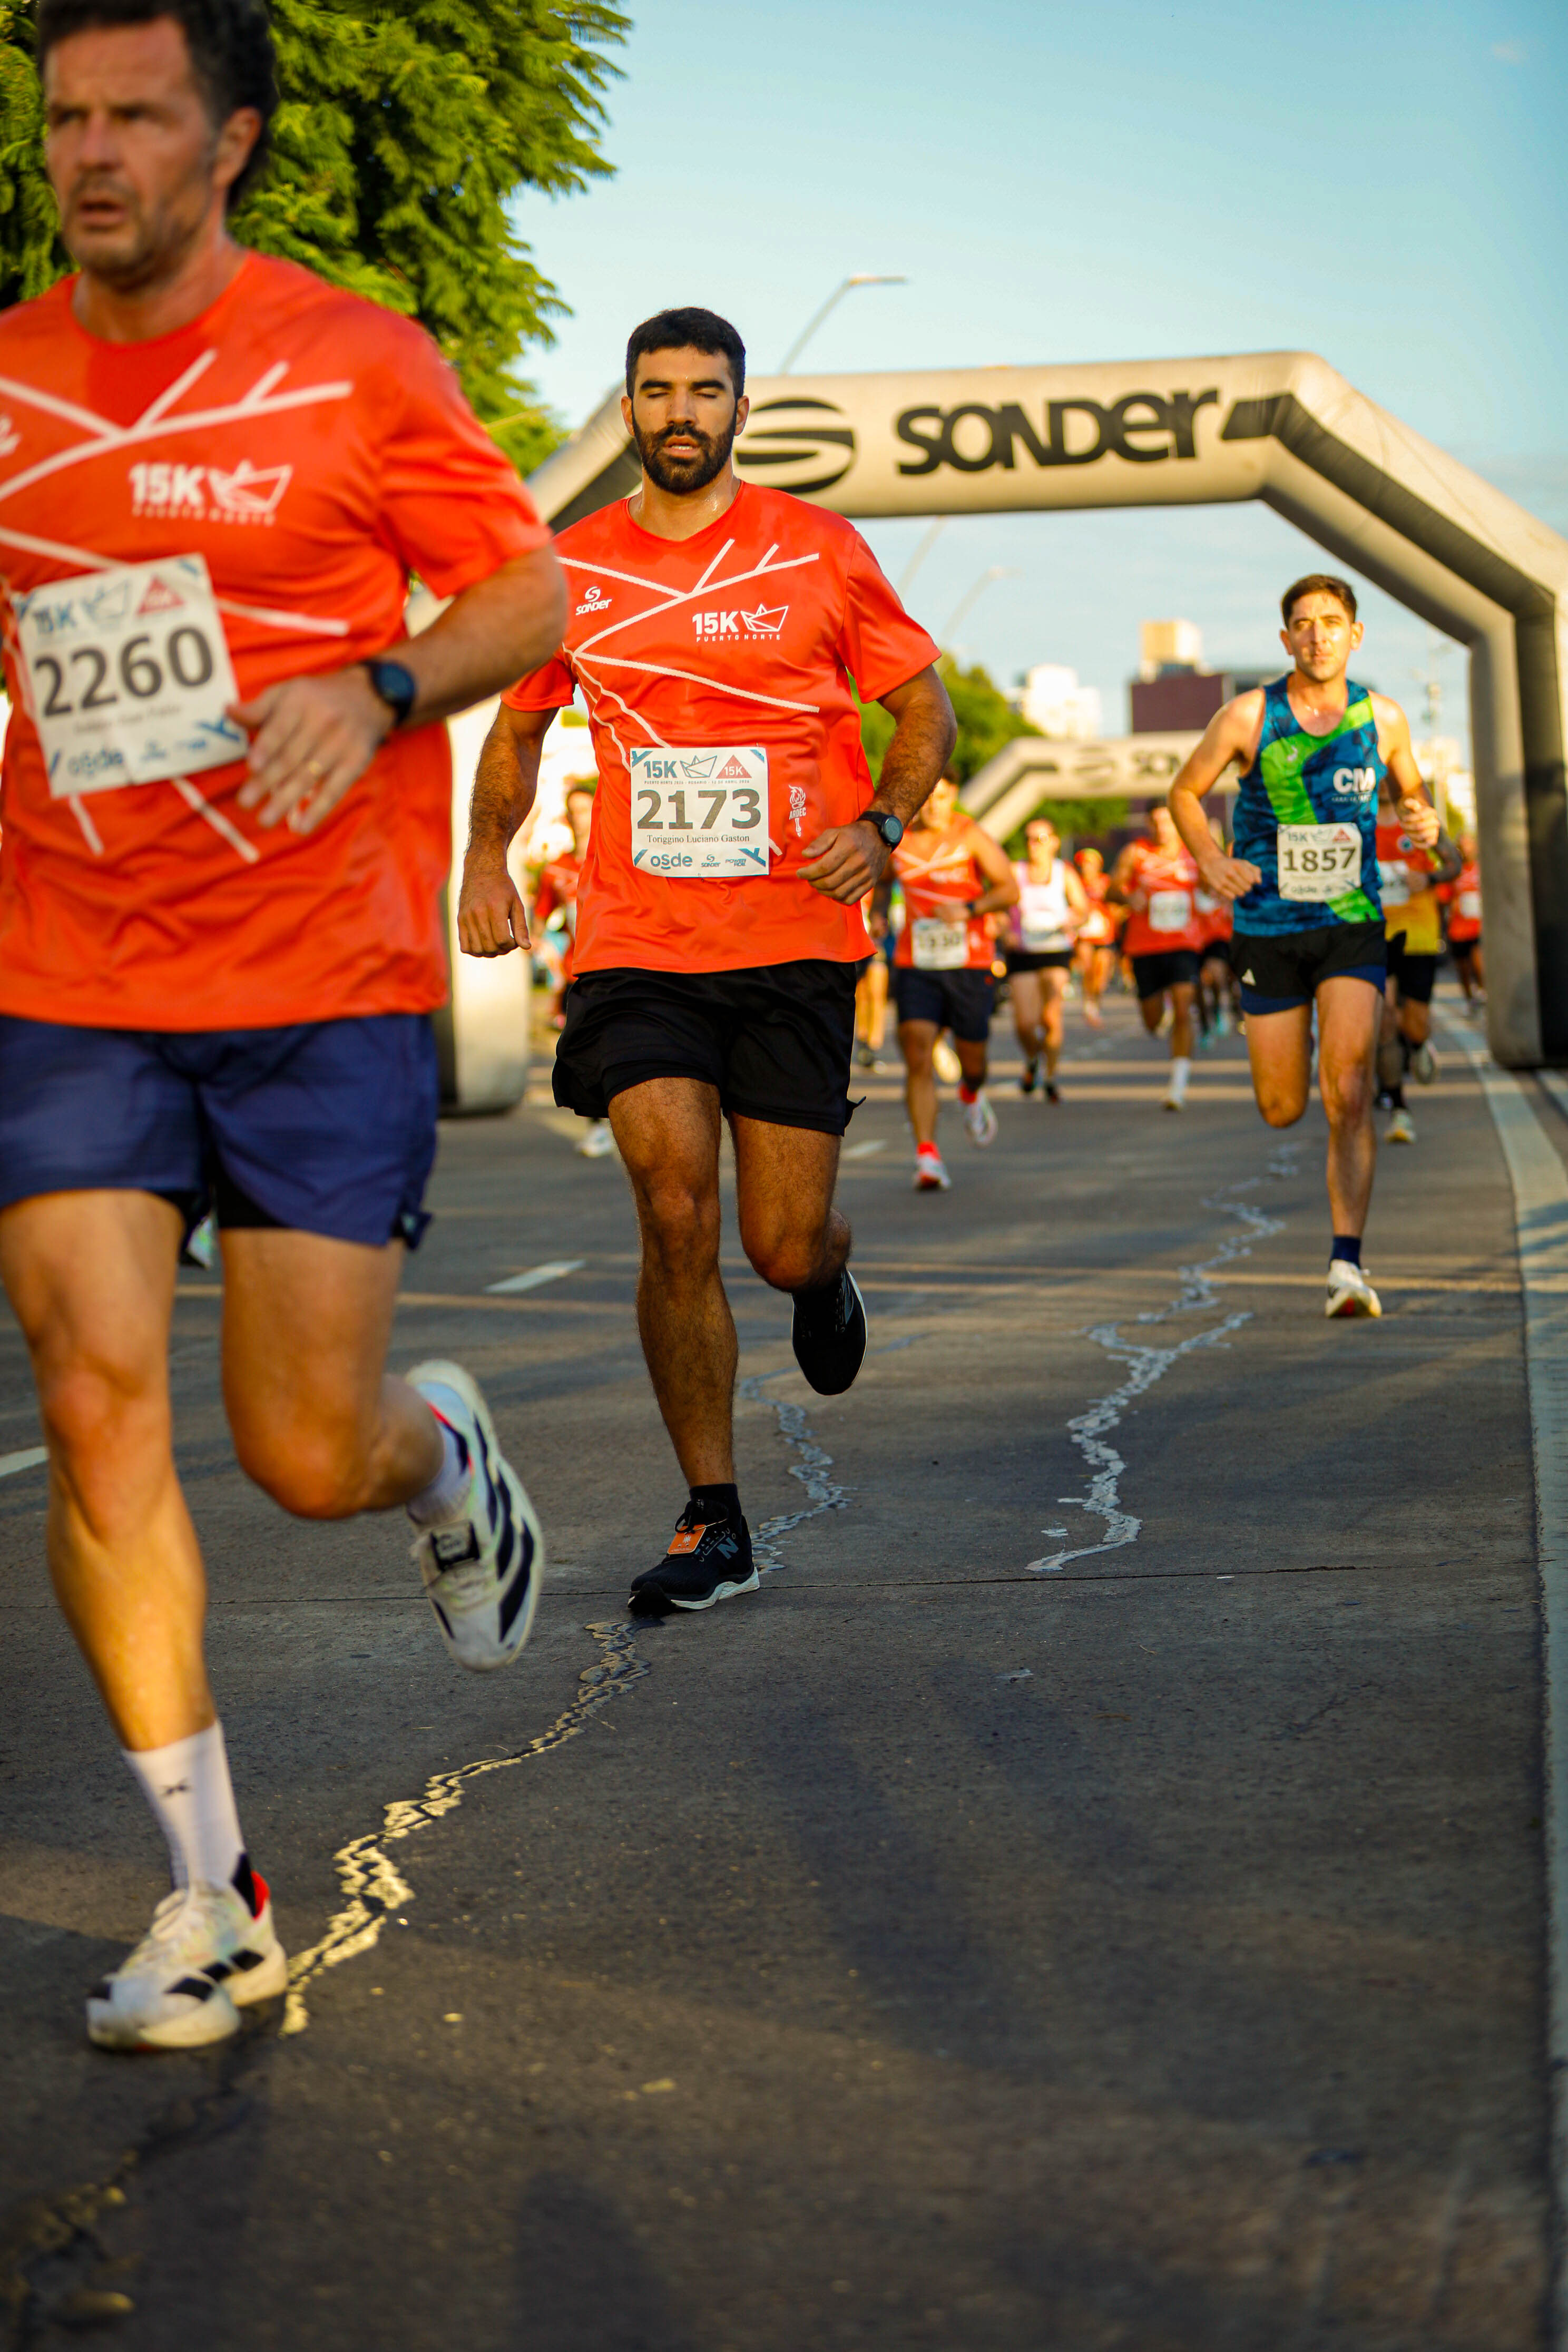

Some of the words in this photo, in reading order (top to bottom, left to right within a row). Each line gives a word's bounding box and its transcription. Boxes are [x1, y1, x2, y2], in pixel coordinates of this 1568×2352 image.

[129, 462, 205, 507] 15K
[692, 611, 739, 634] 15K
[34, 626, 213, 718] 2260
[644, 760, 678, 778] 15K
[724, 766, 743, 776] 15K
[1332, 767, 1376, 794] CM
[637, 788, 761, 829] 2173
[789, 807, 806, 820] ARDEC
[647, 835, 684, 845] Toriggino
[687, 835, 719, 843] Luciano
[721, 834, 750, 842] Gaston
[1287, 831, 1307, 842] 15K
[650, 852, 693, 869] osde
[1282, 846, 1356, 873] 1857
